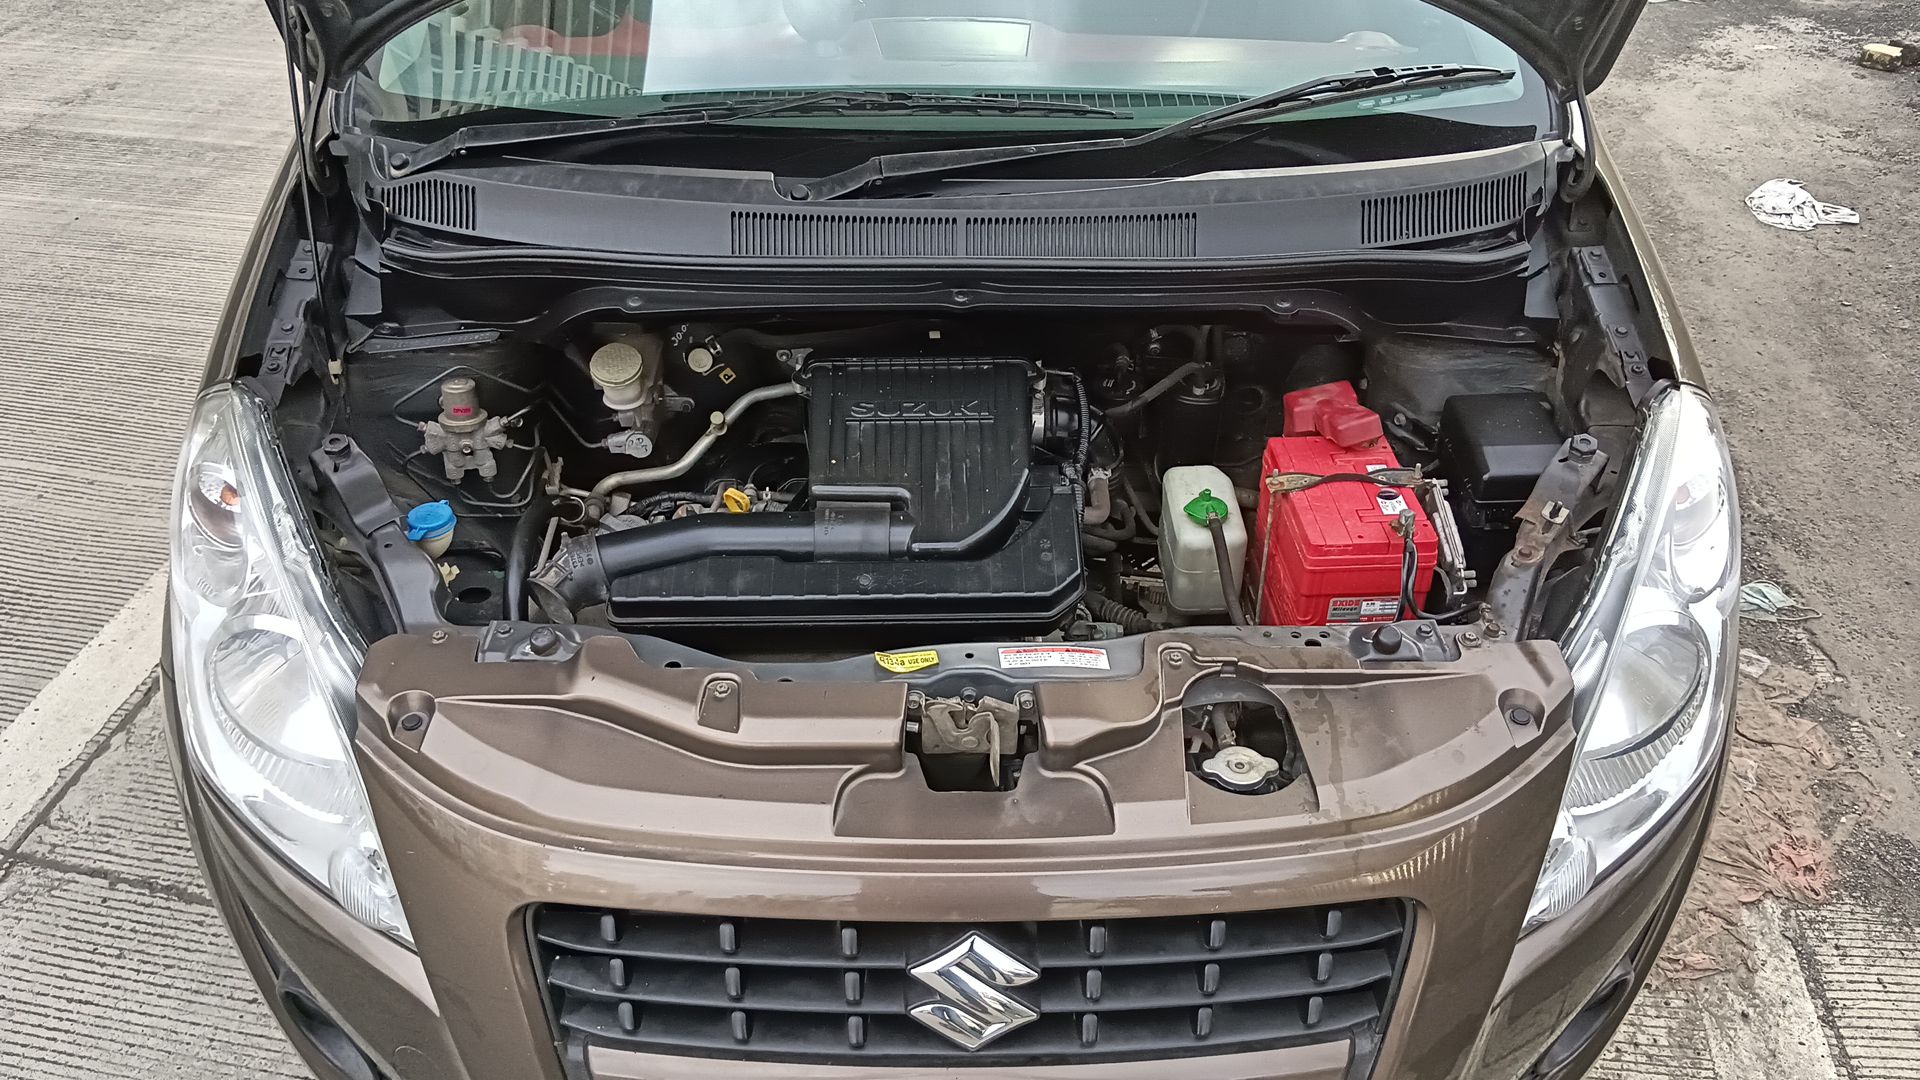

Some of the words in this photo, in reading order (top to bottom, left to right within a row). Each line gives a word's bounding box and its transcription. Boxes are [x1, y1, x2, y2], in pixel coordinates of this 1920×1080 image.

[850, 400, 989, 417] SUZUKI
[1332, 599, 1361, 607] EXIDE
[907, 657, 920, 665] USE
[920, 656, 935, 664] ONLY
